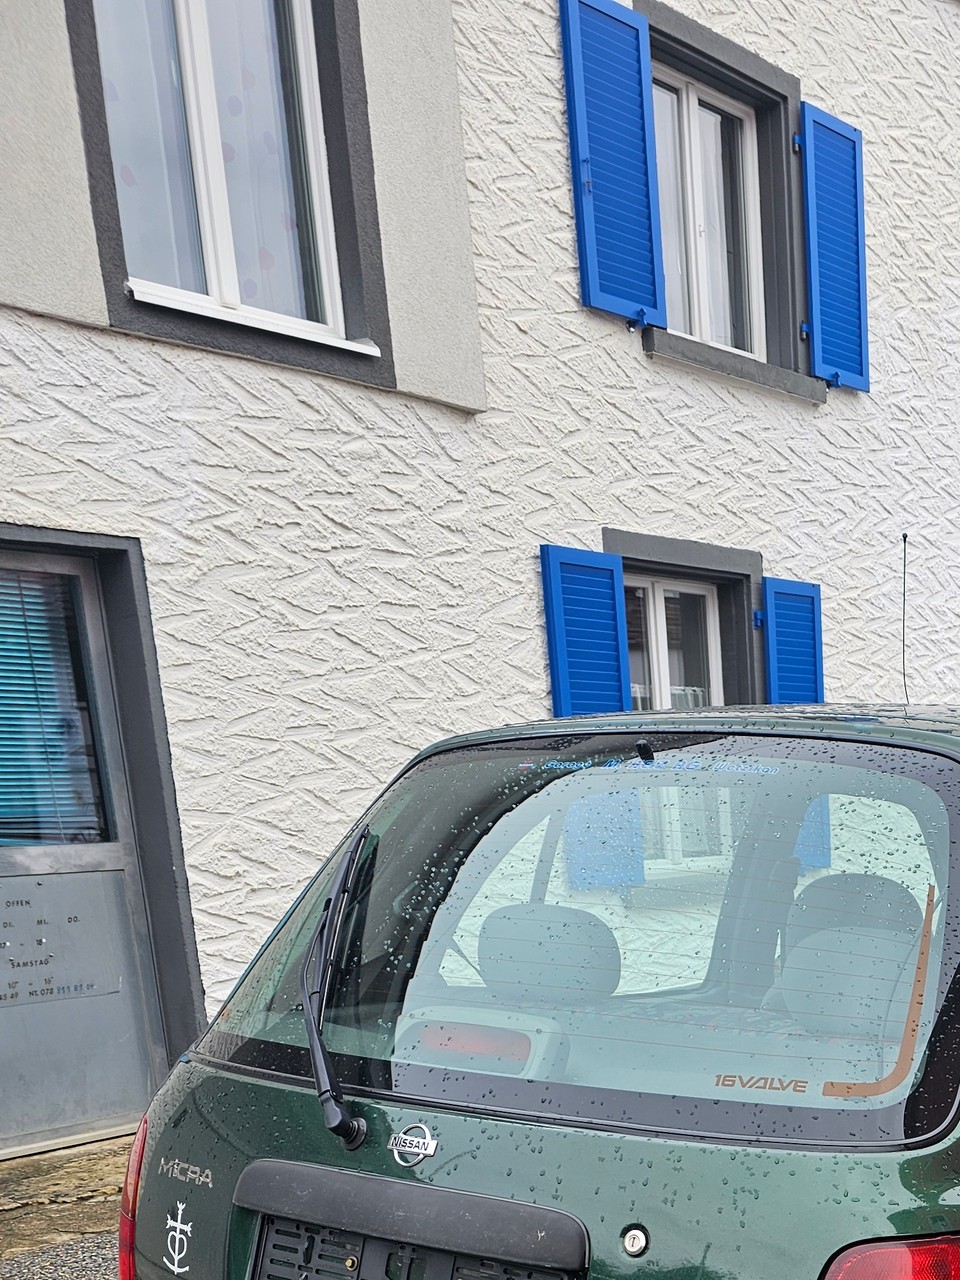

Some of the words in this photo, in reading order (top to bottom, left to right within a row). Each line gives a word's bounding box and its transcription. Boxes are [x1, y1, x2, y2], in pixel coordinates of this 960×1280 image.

[5, 899, 31, 909] OFFEN
[11, 959, 49, 969] SAMSTAG
[714, 1074, 808, 1093] 16VALVE
[391, 1136, 430, 1152] NISSAN
[158, 1157, 213, 1188] MICRA
